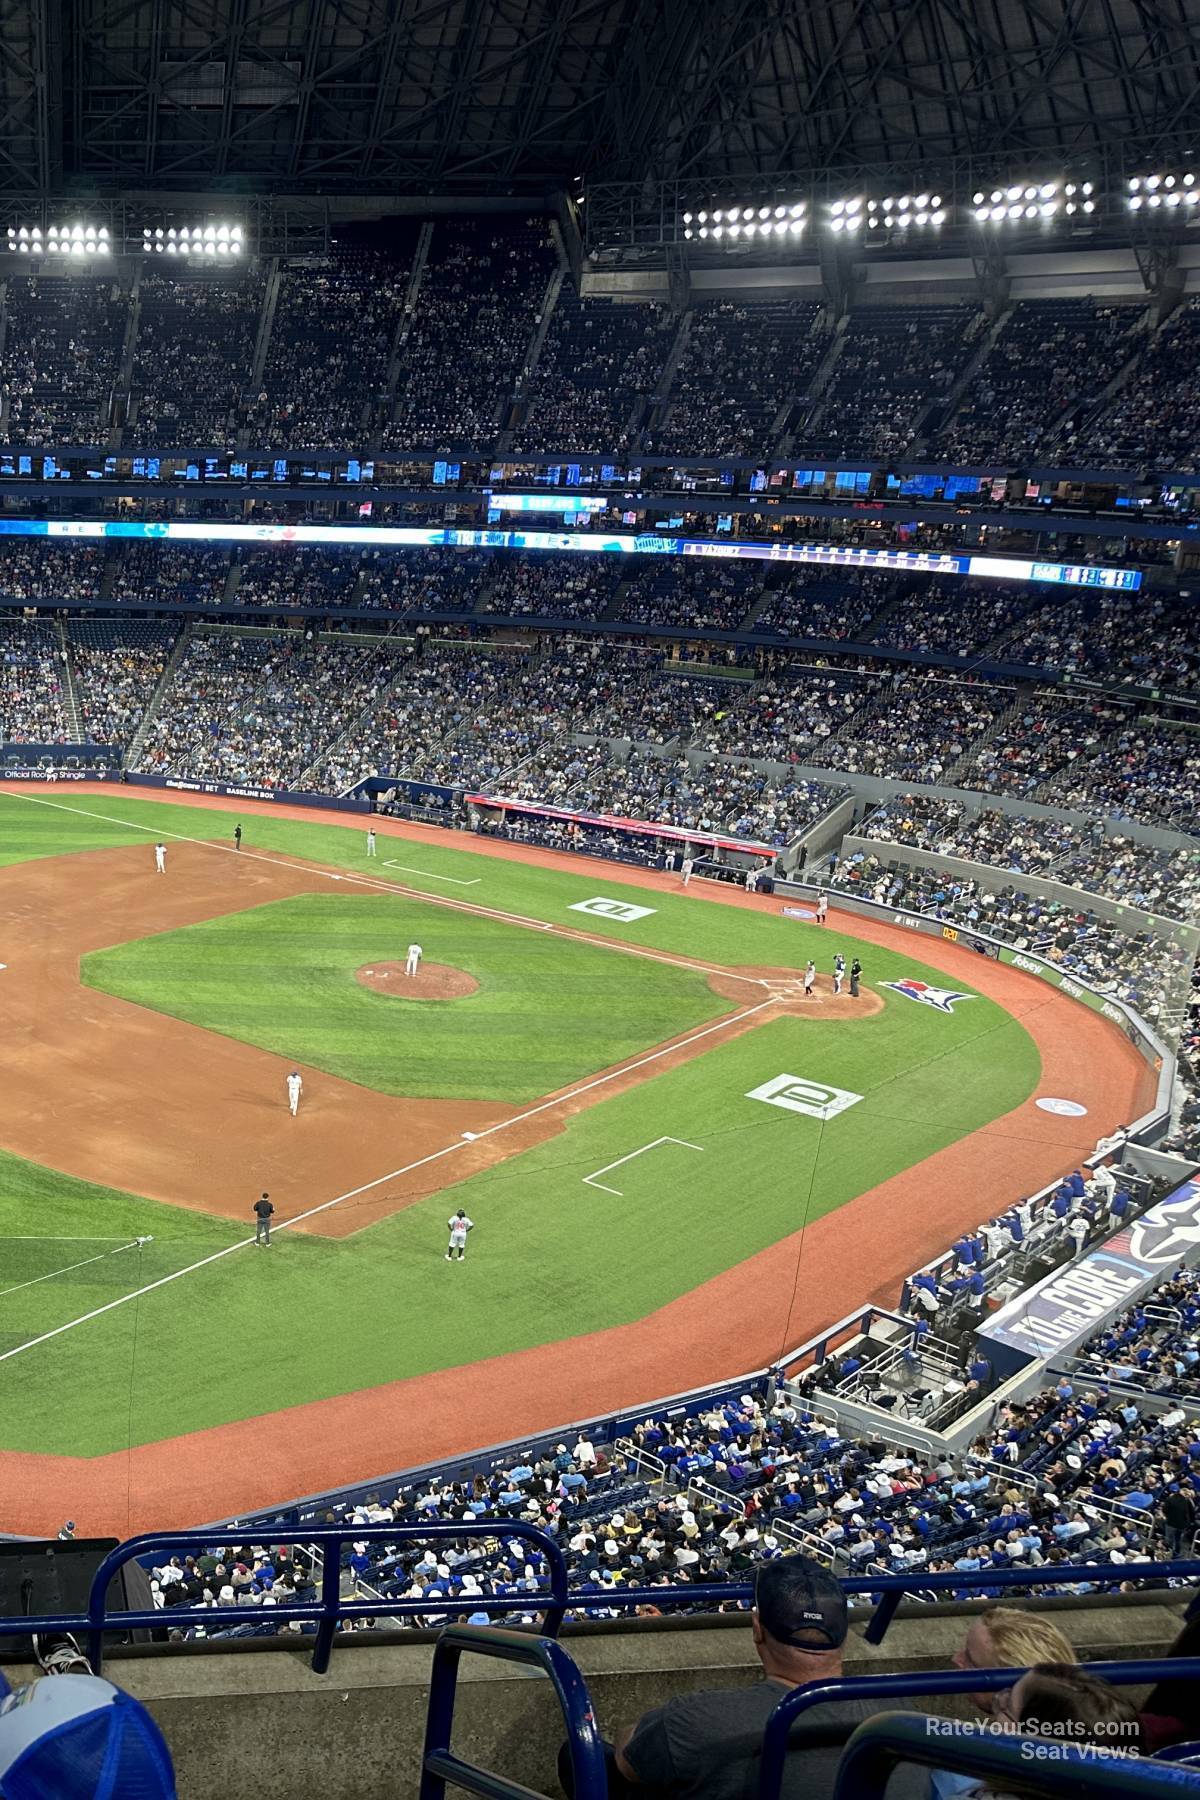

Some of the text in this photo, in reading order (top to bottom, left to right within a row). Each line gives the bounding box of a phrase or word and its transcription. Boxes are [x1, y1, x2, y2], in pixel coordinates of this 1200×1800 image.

[5, 770, 30, 778] Official
[60, 770, 86, 779] Shingle
[166, 780, 201, 790] theScore
[227, 788, 258, 797] BASELINE
[260, 790, 275, 799] BOX
[585, 902, 631, 918] TD
[905, 920, 920, 928] BET
[943, 926, 958, 941] 020
[766, 1083, 838, 1107] TD
[1008, 1261, 1143, 1346] TO THE CORE
